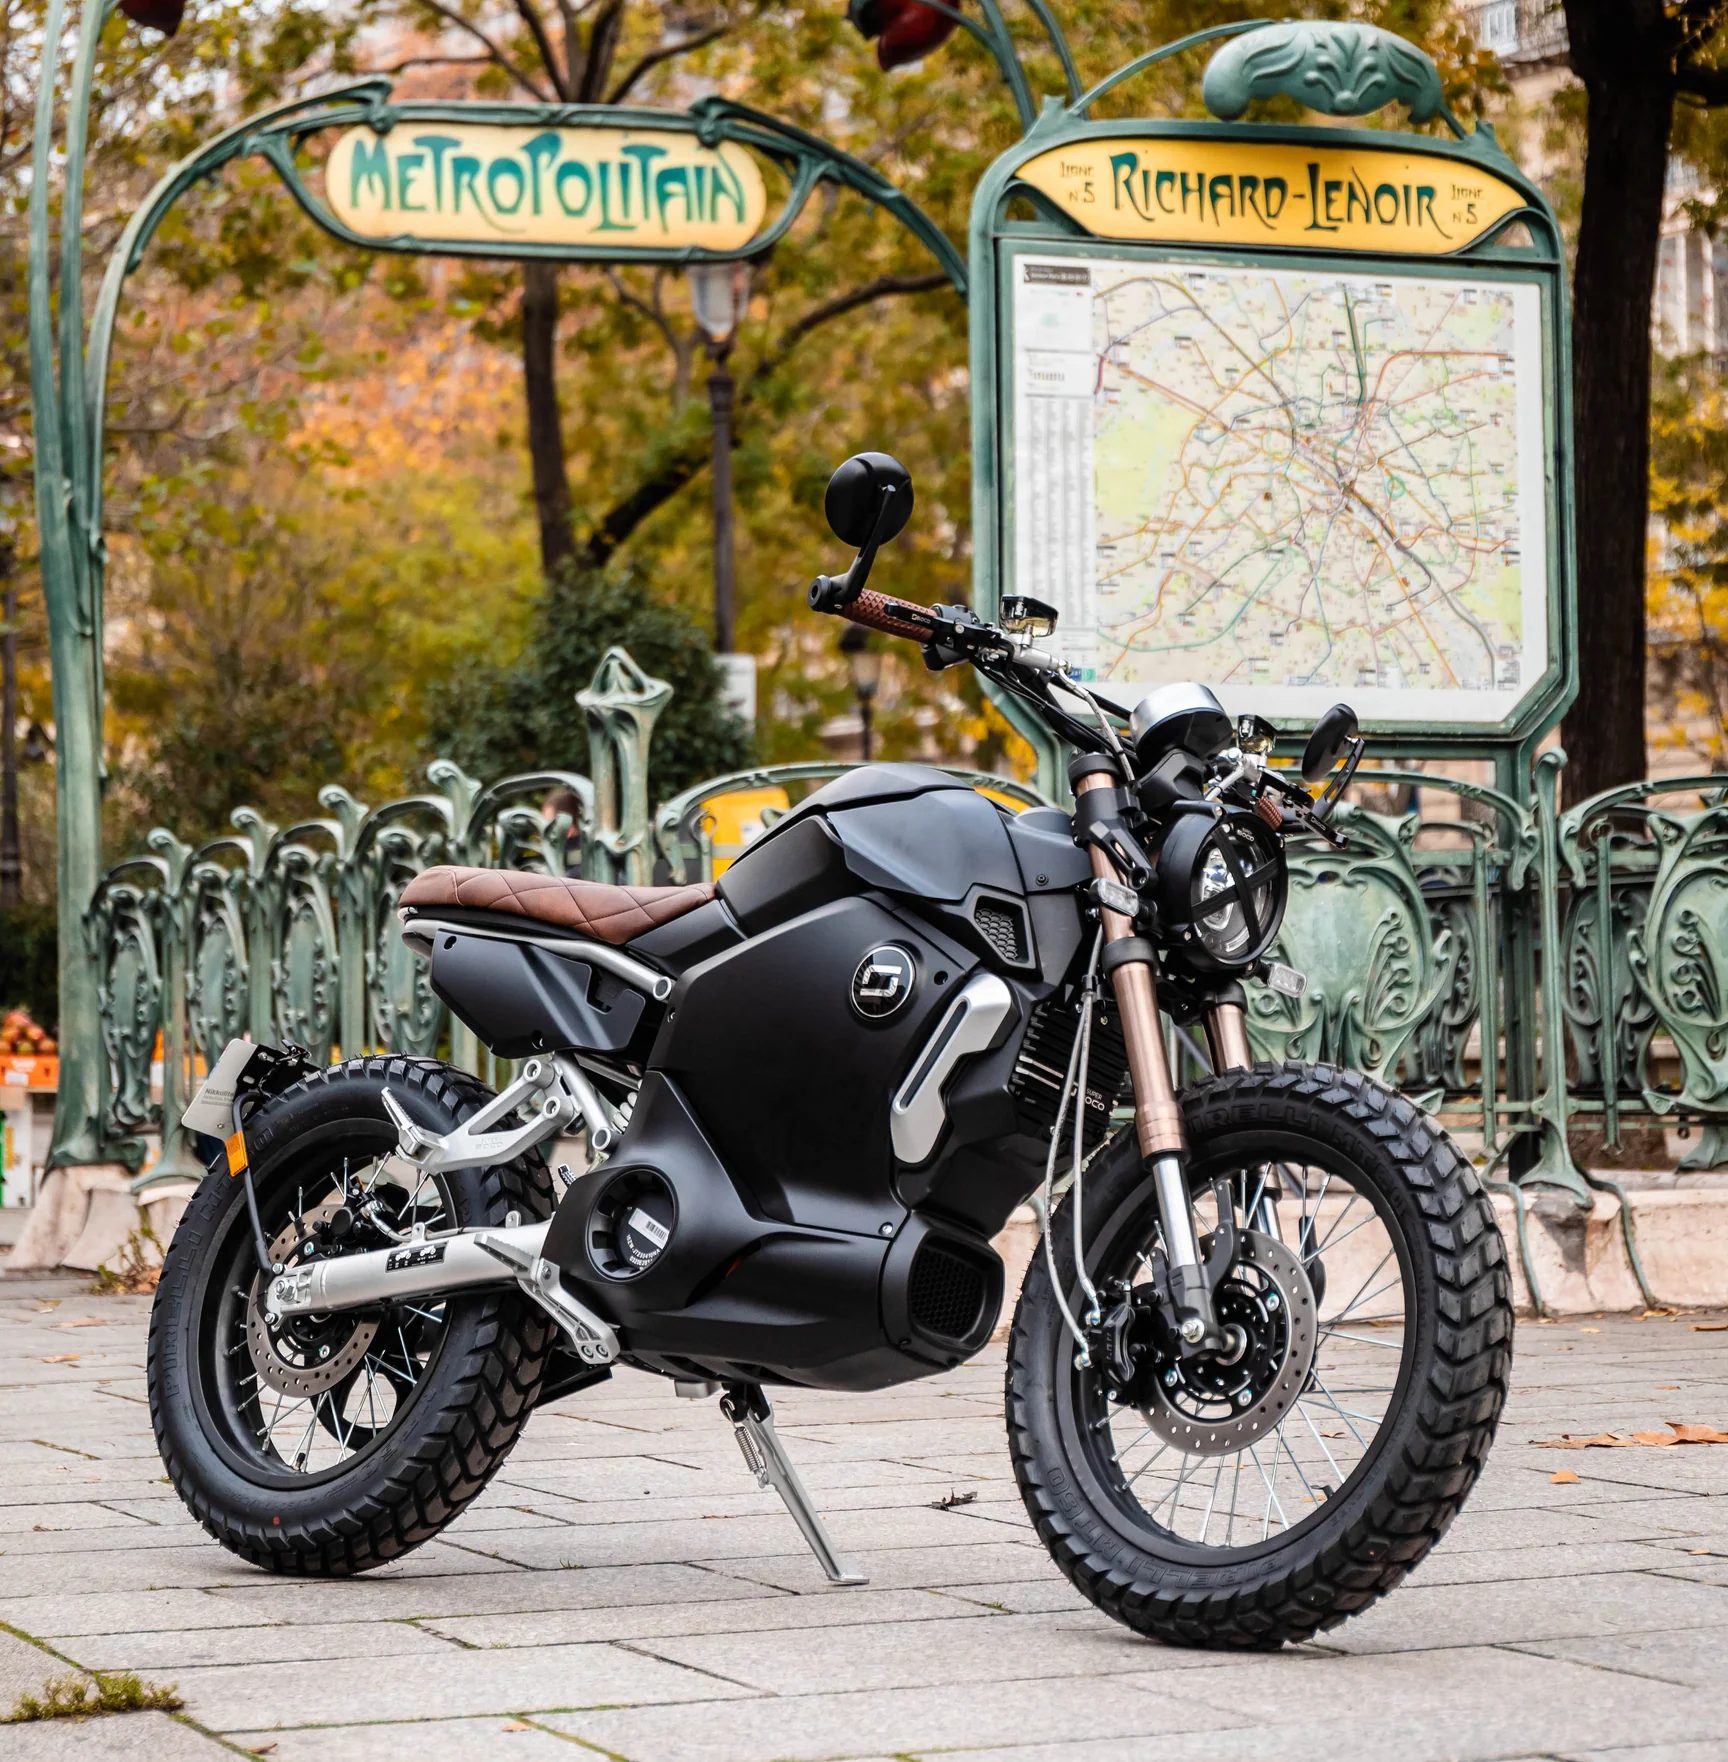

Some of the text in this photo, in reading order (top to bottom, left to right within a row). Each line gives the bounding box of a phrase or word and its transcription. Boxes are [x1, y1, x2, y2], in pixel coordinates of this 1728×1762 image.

[350, 130, 746, 232] METROPOLITAIN
[1084, 1096, 1105, 1112] OCO
[1186, 1103, 1320, 1134] IRELLI
